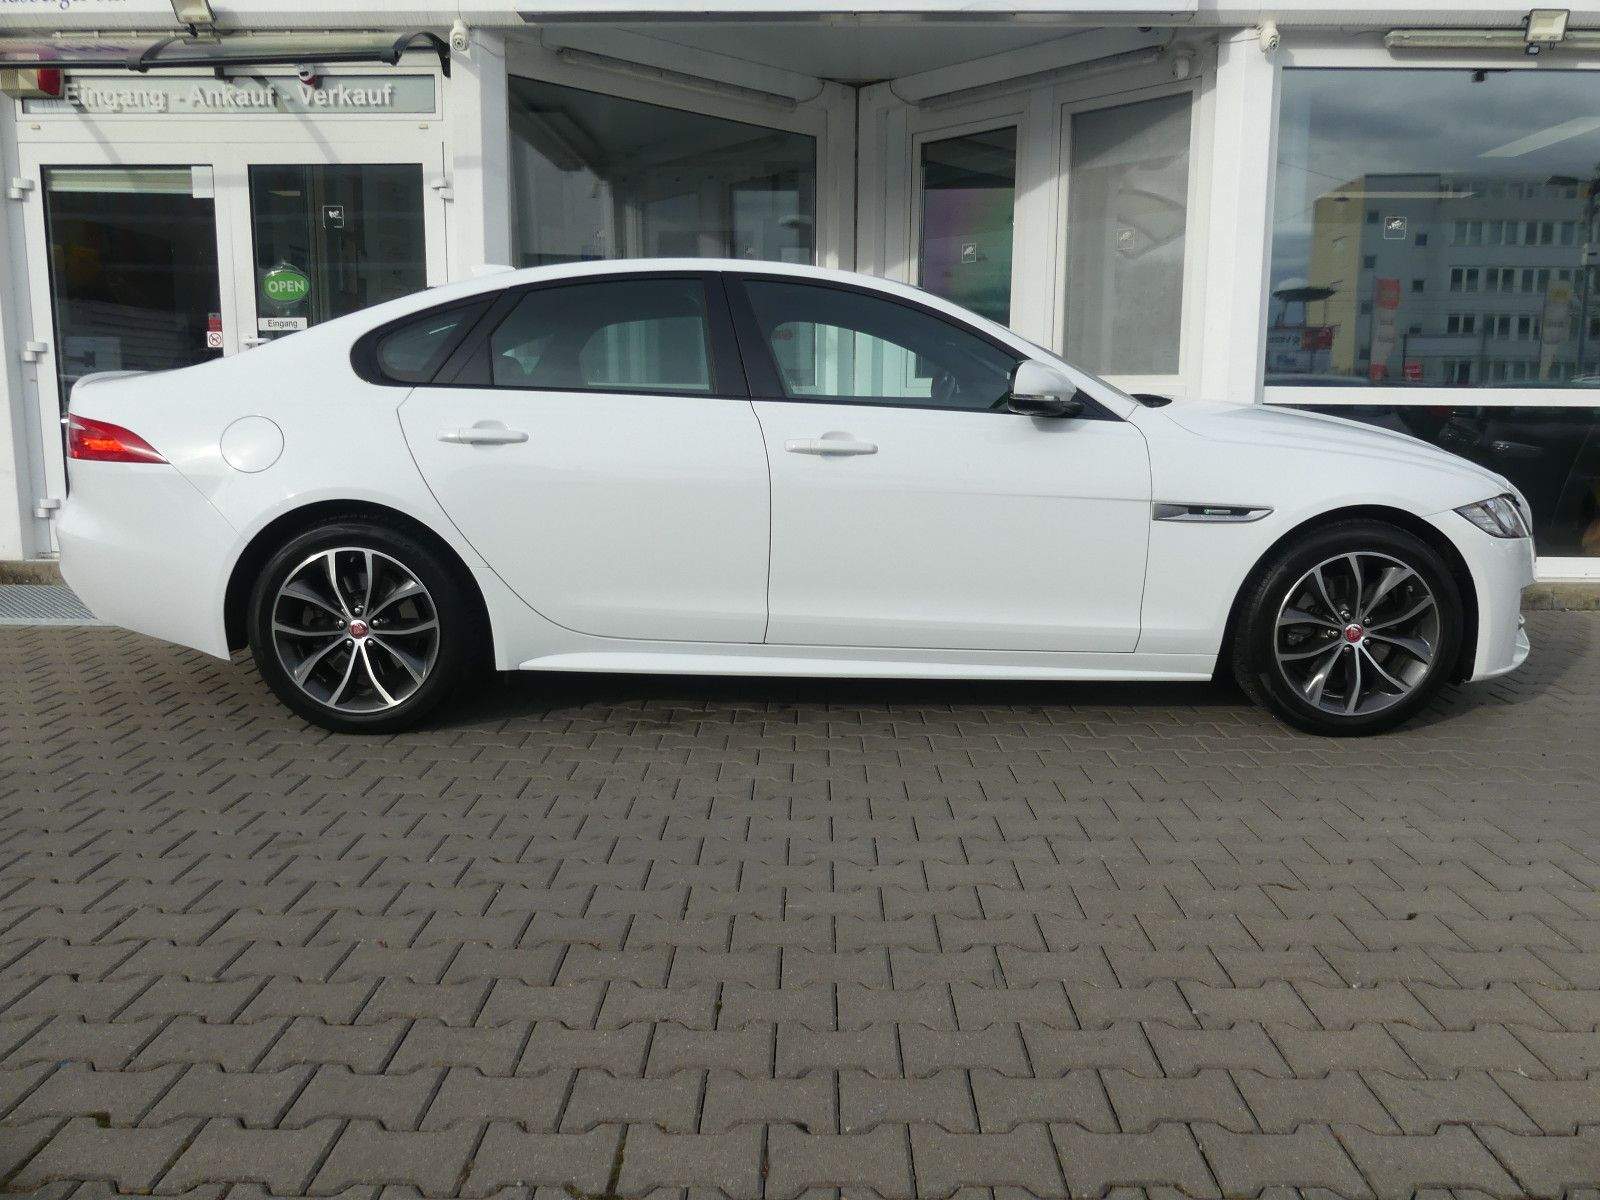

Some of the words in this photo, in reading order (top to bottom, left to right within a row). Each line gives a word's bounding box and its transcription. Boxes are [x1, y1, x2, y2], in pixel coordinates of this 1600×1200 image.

[66, 82, 168, 112] Eingang
[192, 83, 275, 107] Ankauf
[299, 82, 393, 107] Verkauf
[268, 280, 305, 293] OPEN
[267, 319, 298, 329] Eingang
